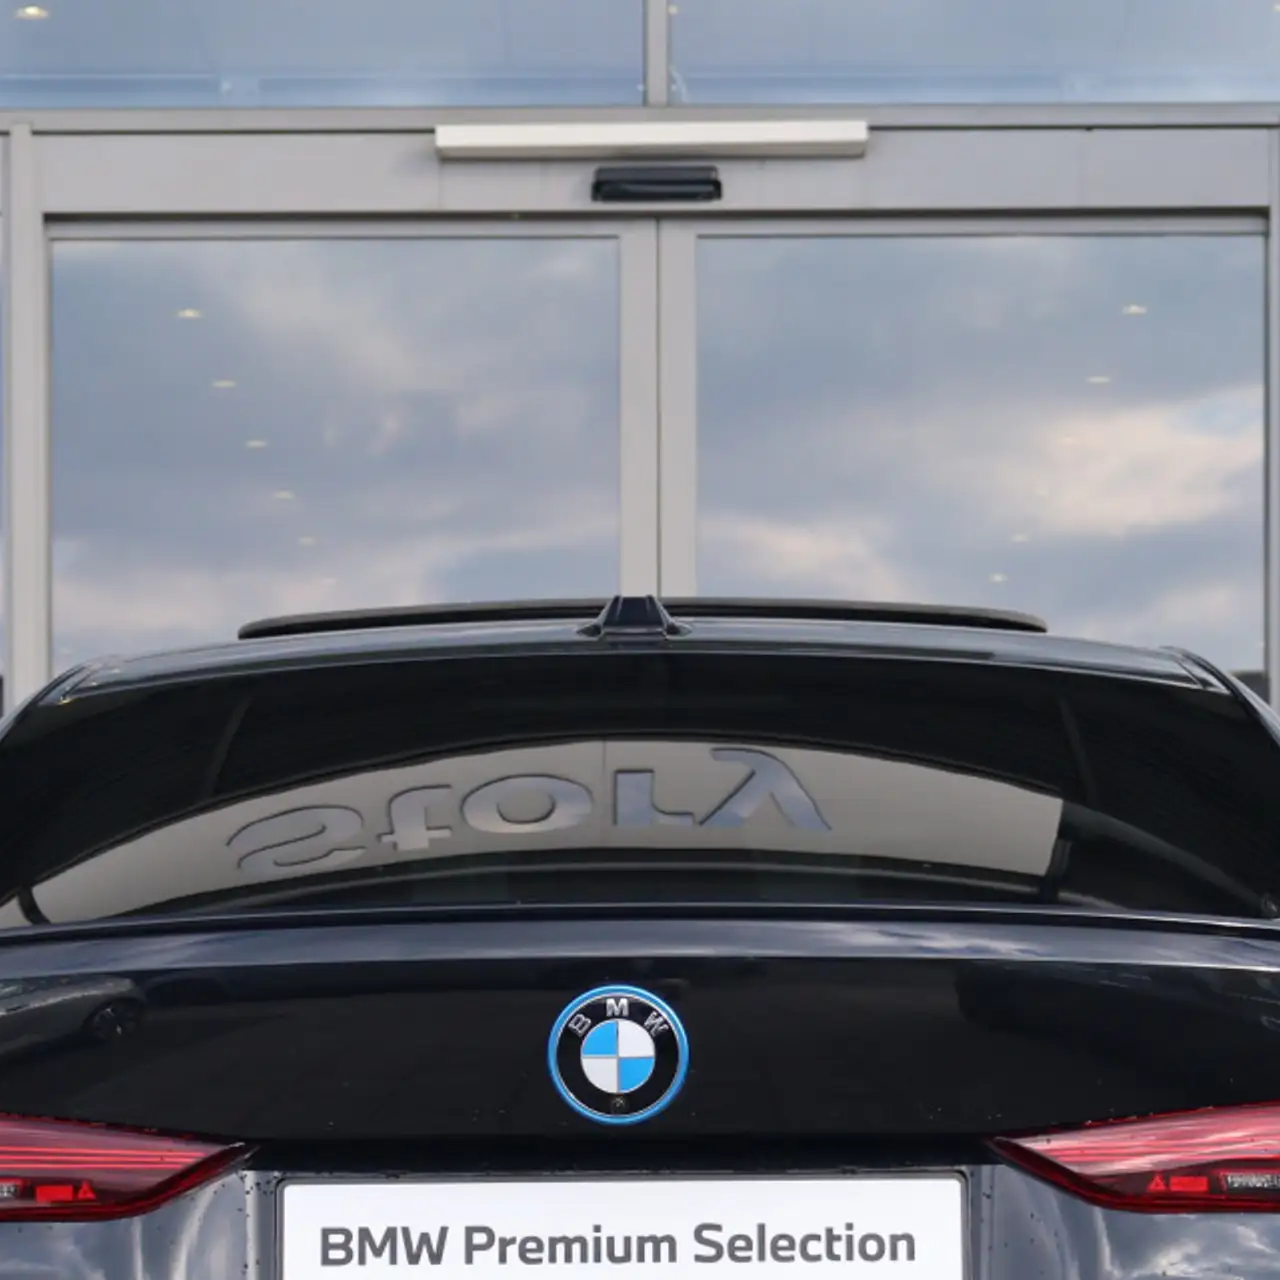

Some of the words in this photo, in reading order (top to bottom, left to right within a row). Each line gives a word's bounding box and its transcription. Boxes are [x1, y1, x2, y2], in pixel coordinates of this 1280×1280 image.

[568, 998, 670, 1038] BMW
[320, 1225, 450, 1267] BMW
[464, 1224, 678, 1266] Premium
[693, 1221, 917, 1264] Selection
